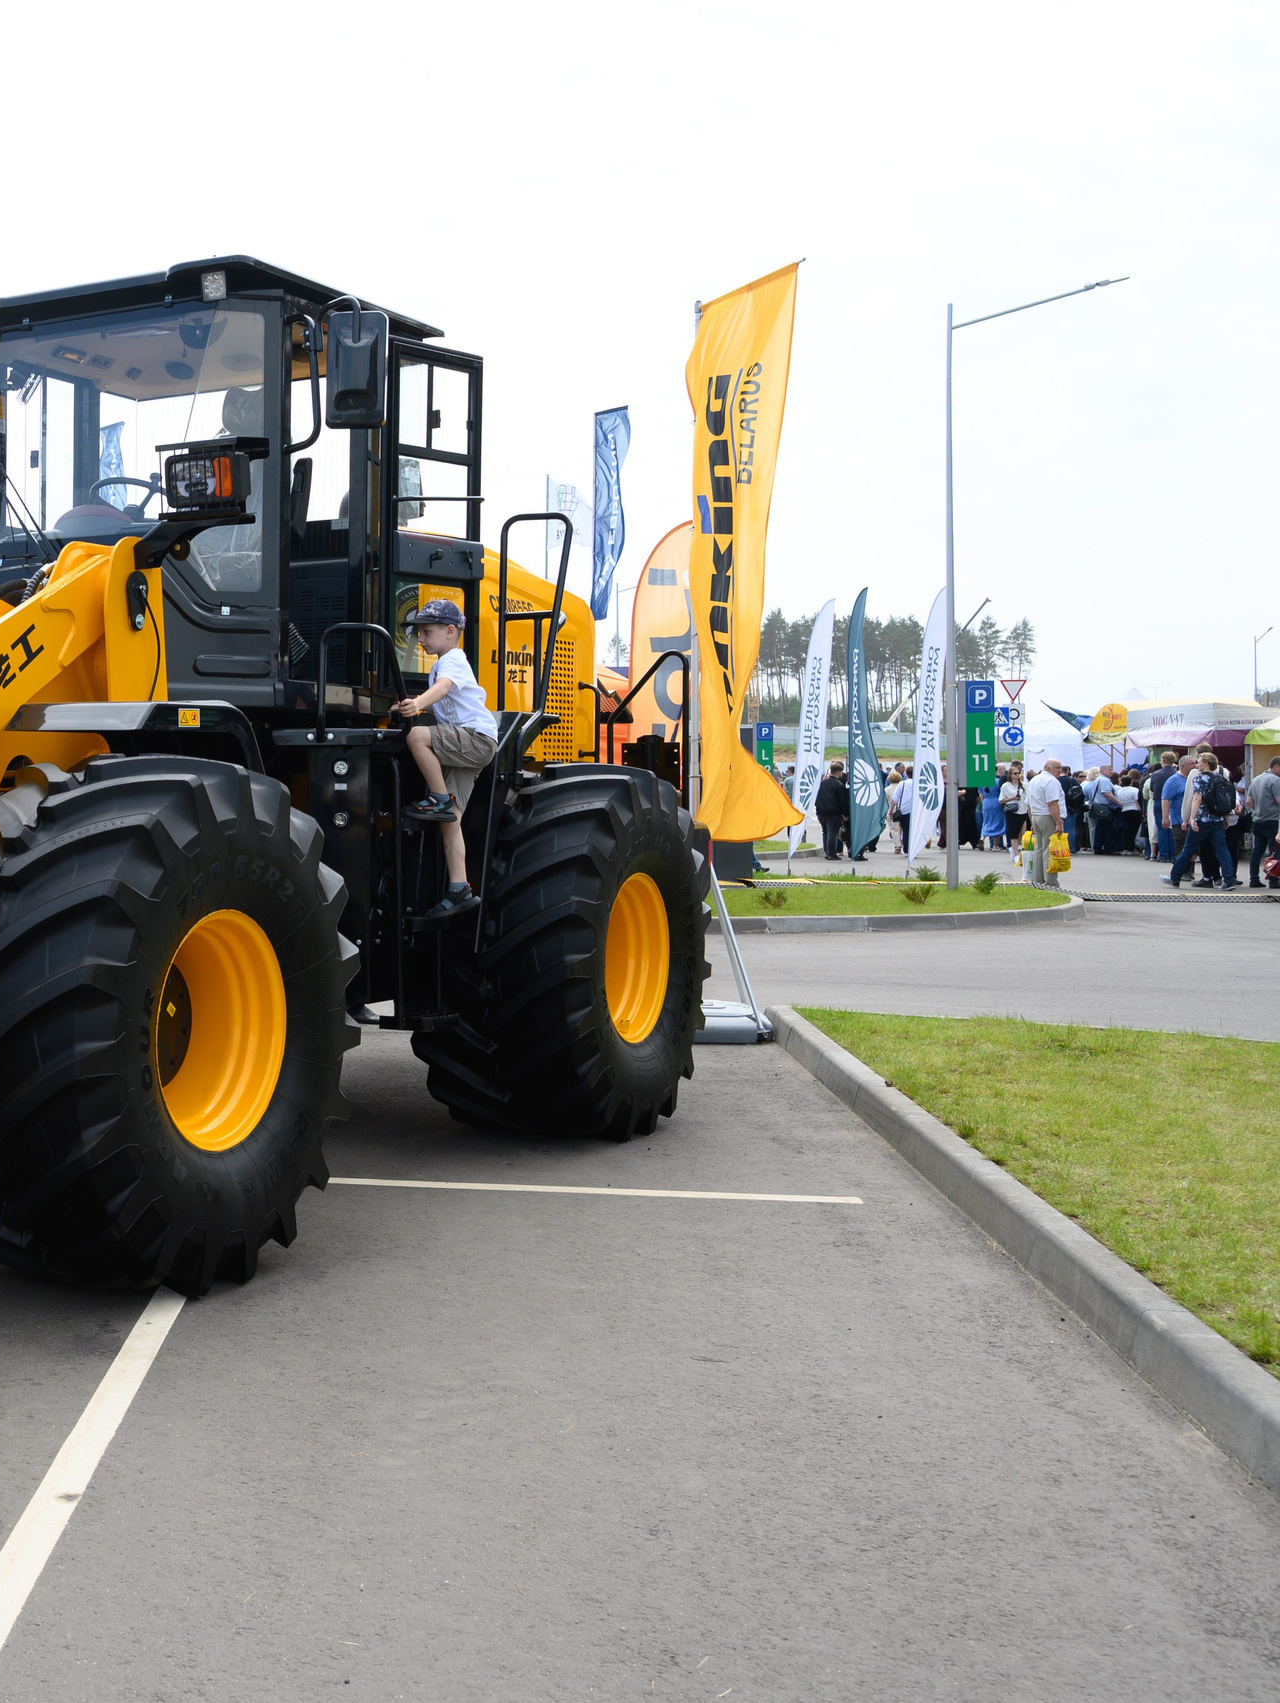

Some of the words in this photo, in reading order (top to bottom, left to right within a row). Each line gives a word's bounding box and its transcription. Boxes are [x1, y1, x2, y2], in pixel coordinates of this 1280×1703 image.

[737, 362, 762, 485] BELARUS
[491, 644, 536, 667] LNKIN
[803, 656, 818, 753] ЩЕЛКОВО
[812, 657, 823, 755] АГРОХИМ
[927, 648, 941, 751] АГРОХИМ
[975, 689, 988, 705] P
[761, 727, 769, 737] P
[975, 727, 987, 746] L
[761, 749, 769, 760] L
[972, 754, 989, 772] 11
